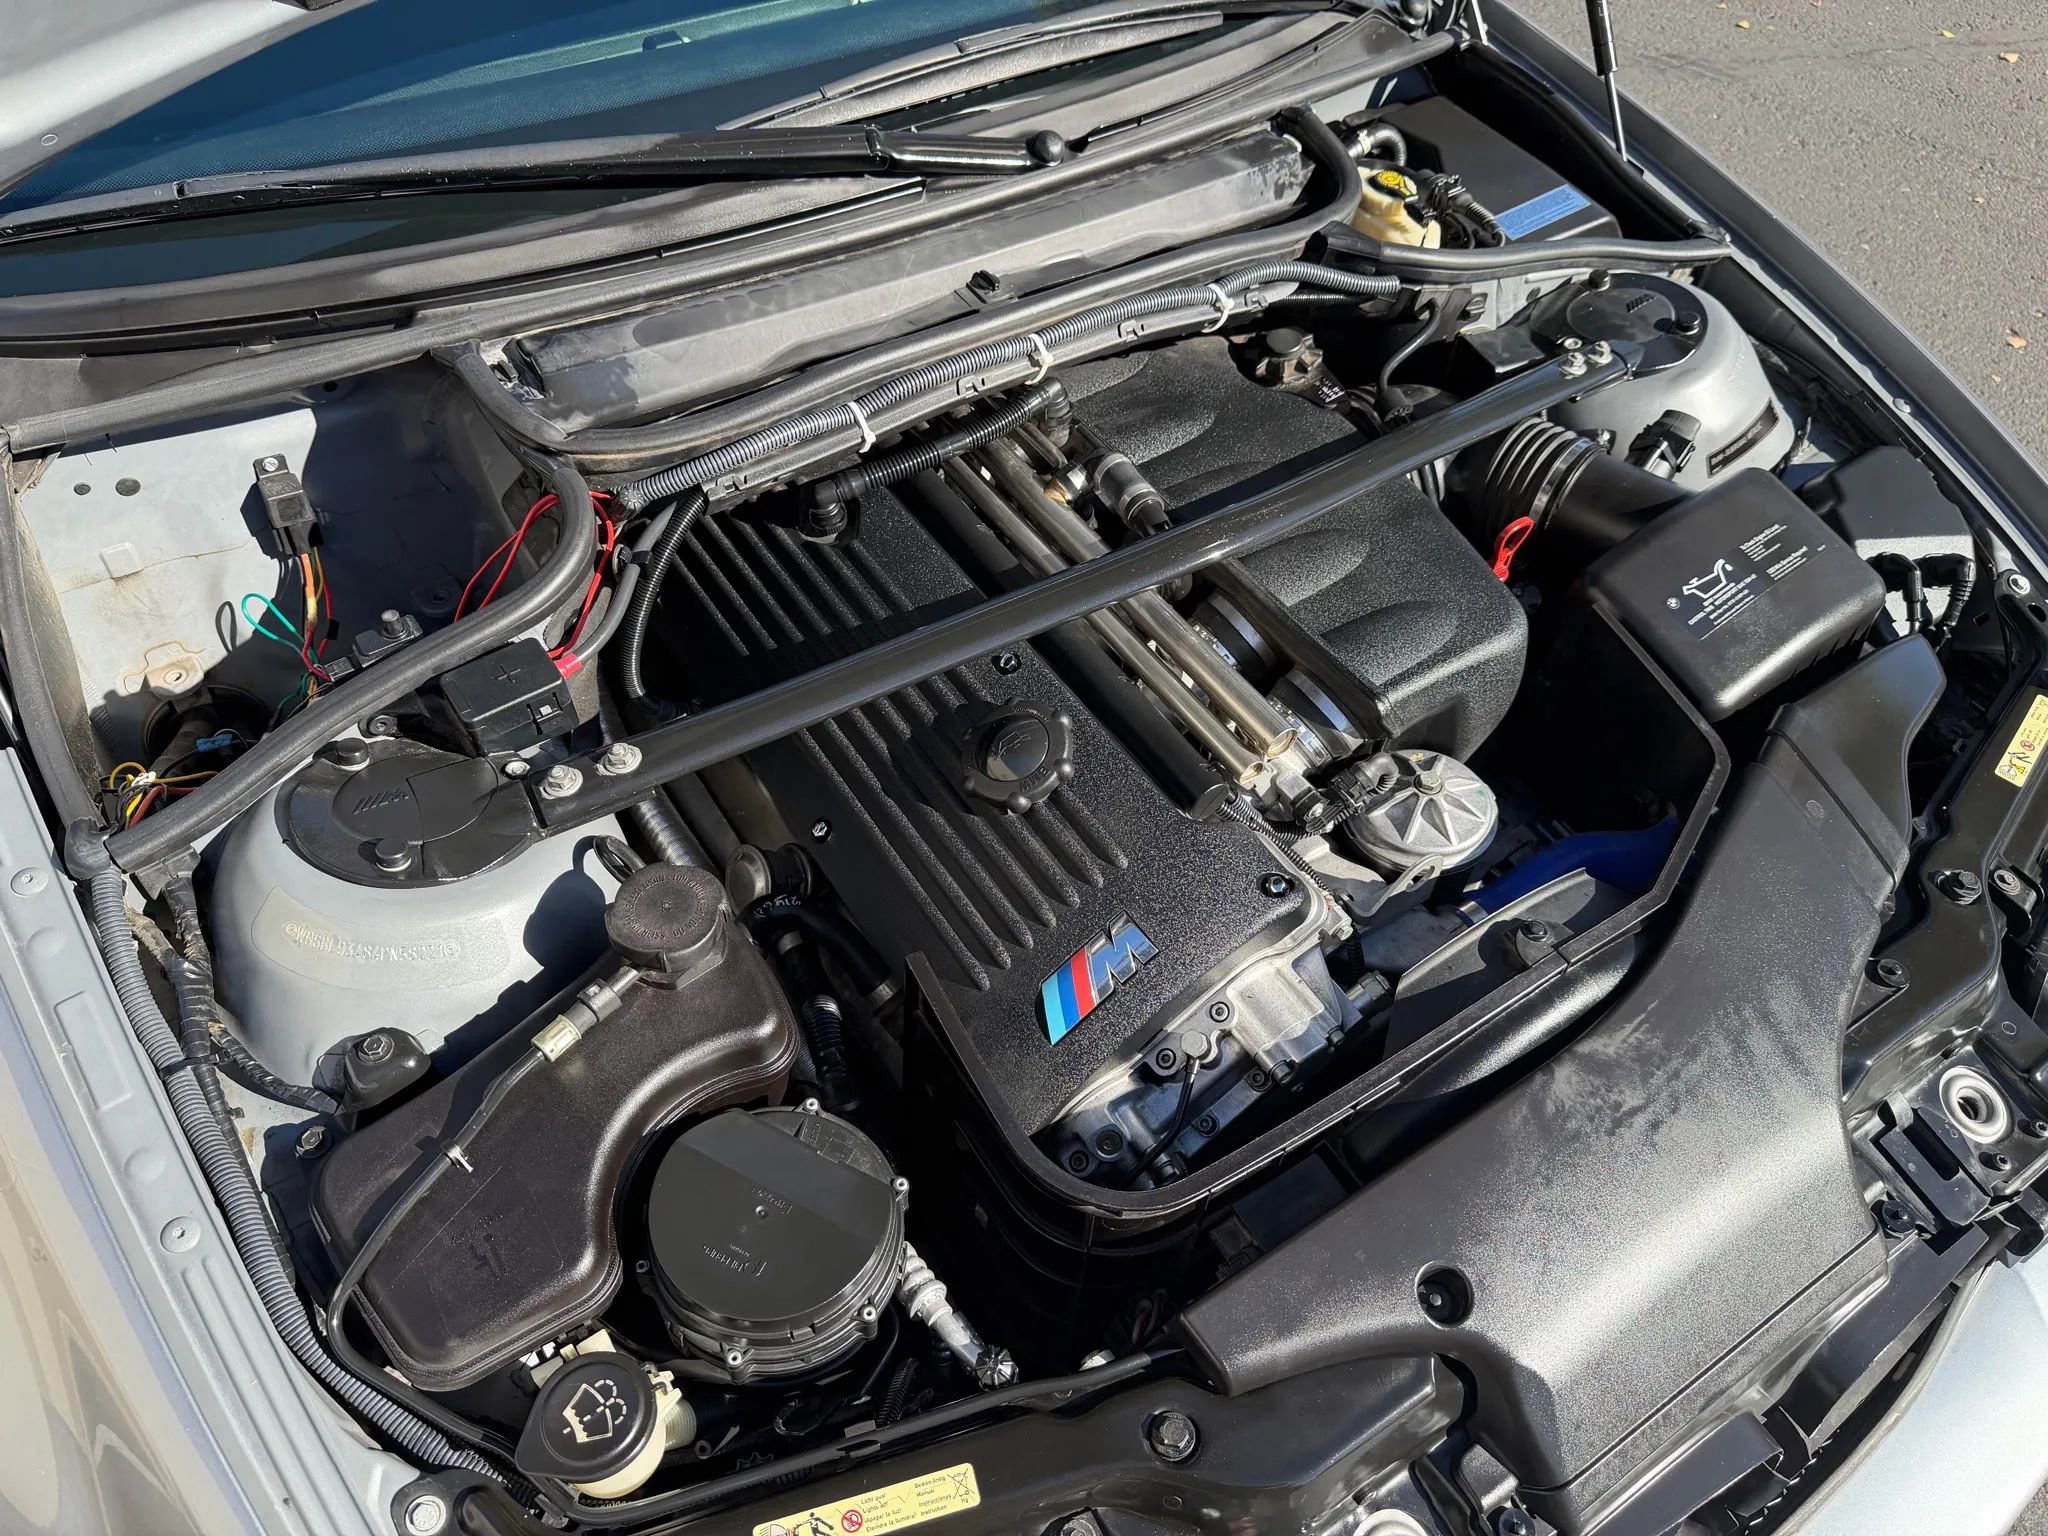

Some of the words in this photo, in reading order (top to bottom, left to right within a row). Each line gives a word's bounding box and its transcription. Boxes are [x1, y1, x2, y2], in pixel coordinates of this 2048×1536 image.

[916, 1488, 935, 1498] Manual
[860, 1496, 874, 1505] Licht
[920, 1504, 948, 1517] Instruction
